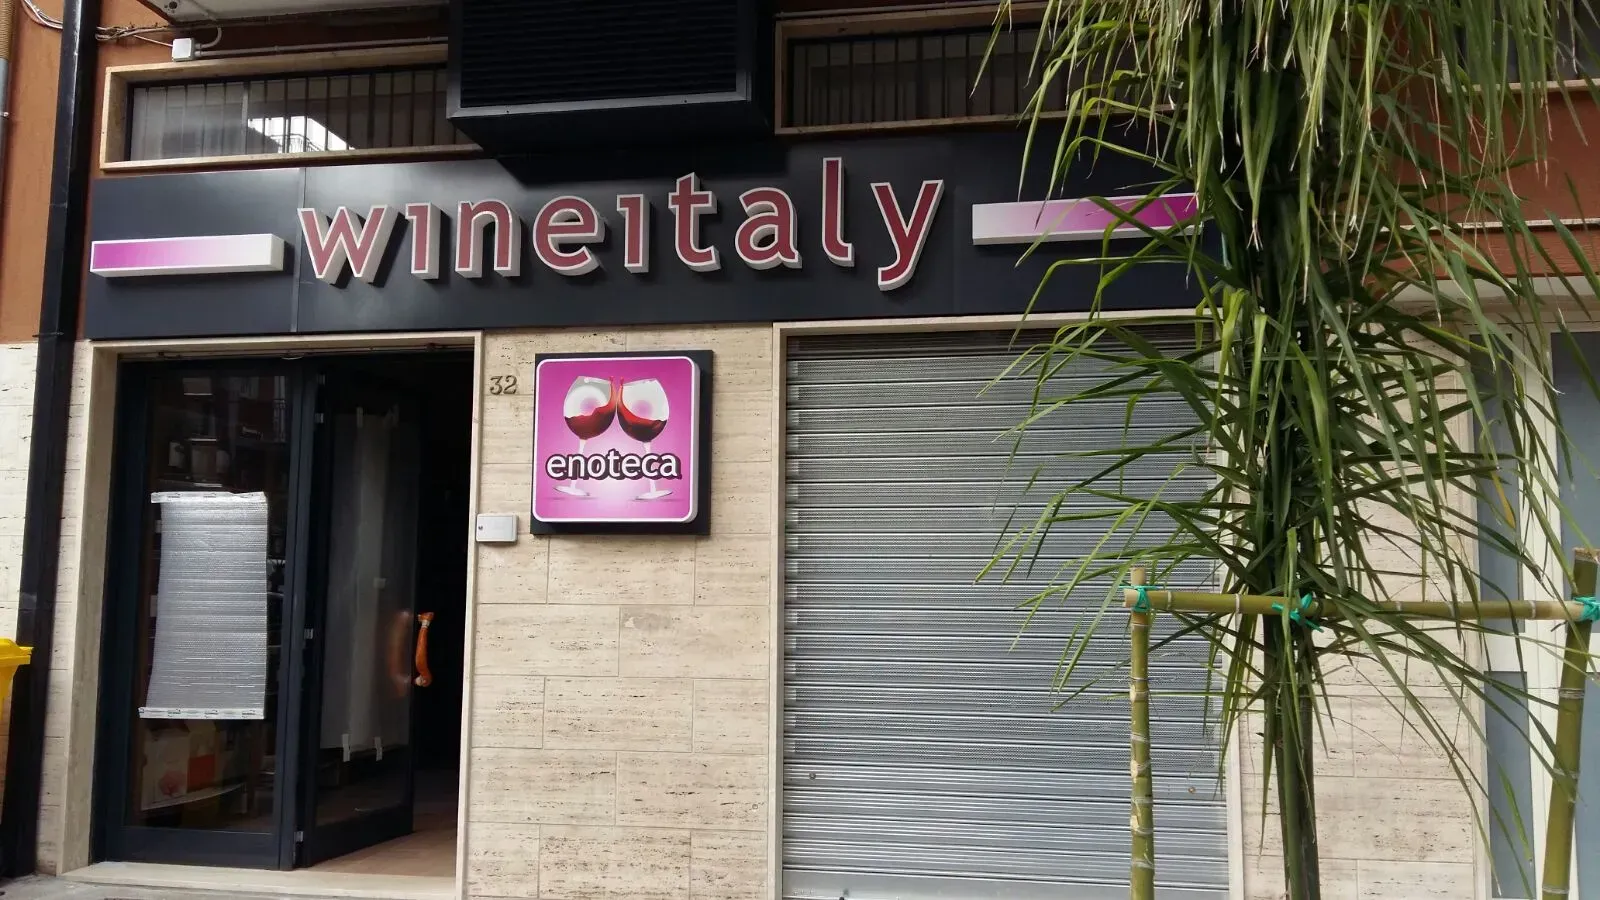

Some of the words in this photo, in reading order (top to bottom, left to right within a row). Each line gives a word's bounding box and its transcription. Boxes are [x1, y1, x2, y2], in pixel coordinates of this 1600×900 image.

[297, 157, 944, 291] wineitaly
[490, 375, 517, 395] 32
[546, 450, 681, 480] enoteca
